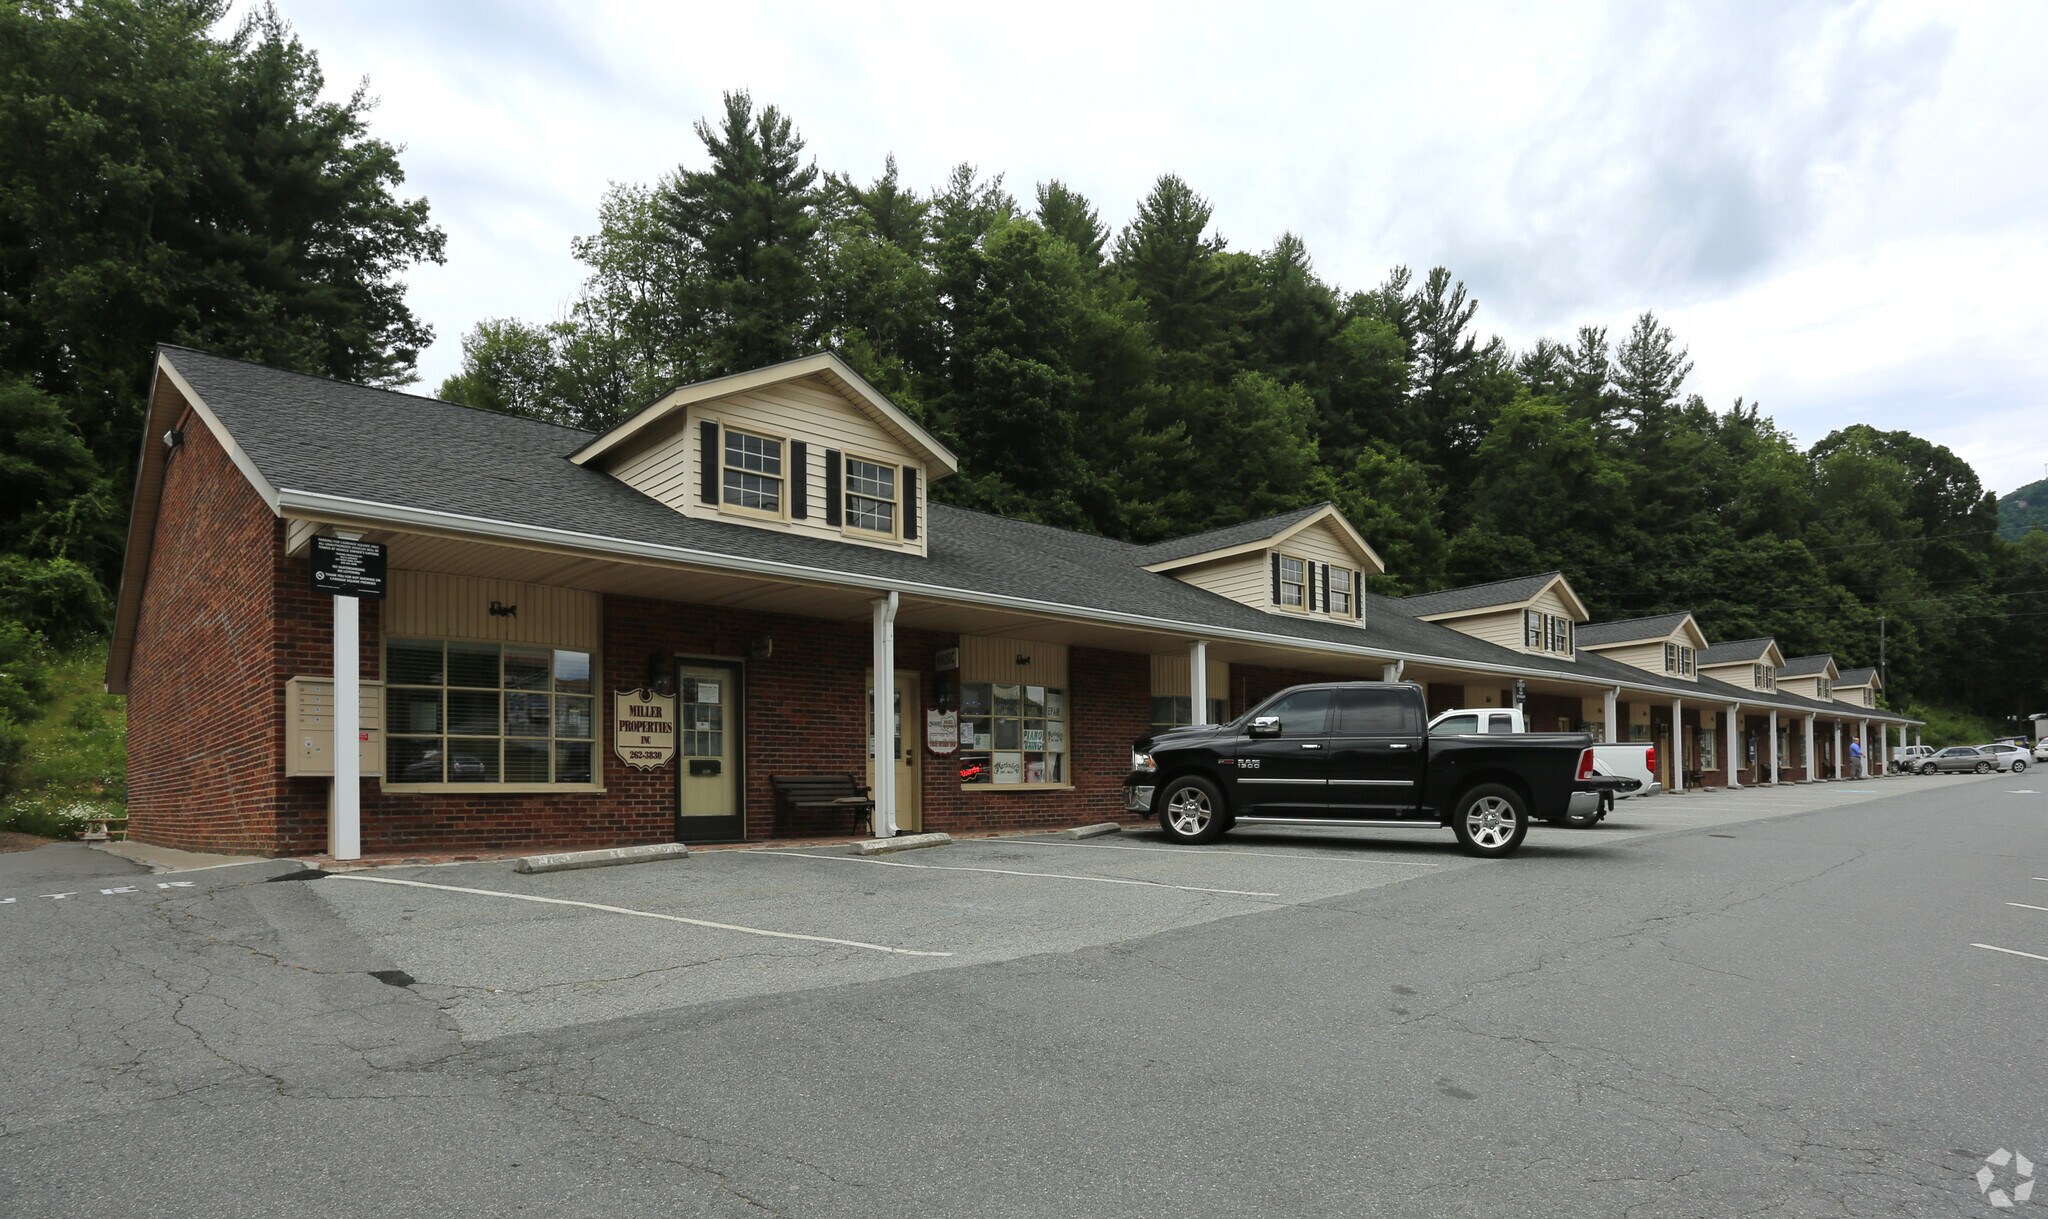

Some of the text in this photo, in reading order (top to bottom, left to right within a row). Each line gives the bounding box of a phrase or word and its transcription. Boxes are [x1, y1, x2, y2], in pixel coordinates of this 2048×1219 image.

[629, 705, 662, 718] MILLER
[619, 720, 672, 733] PROPERTIES
[640, 735, 651, 744] INC
[1024, 730, 1043, 740] PIANO
[629, 750, 662, 760] 262-3830
